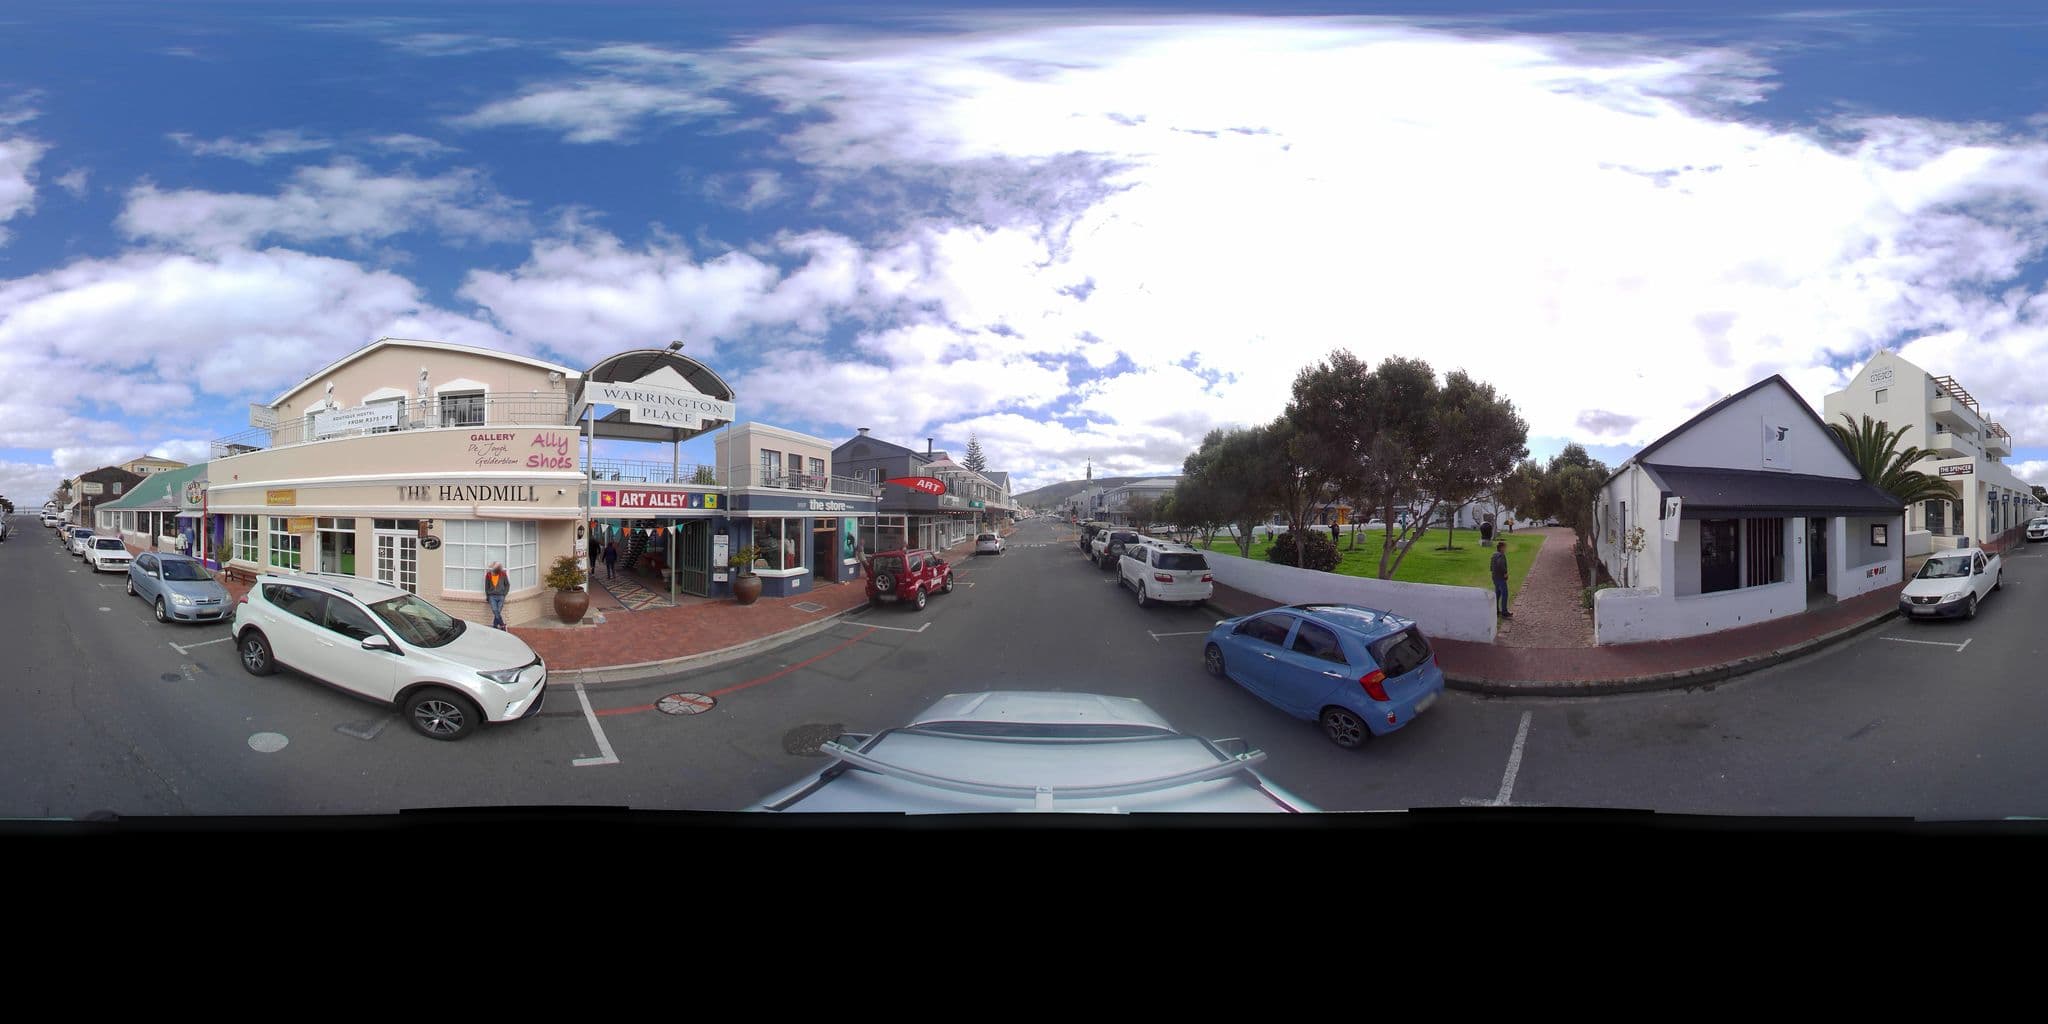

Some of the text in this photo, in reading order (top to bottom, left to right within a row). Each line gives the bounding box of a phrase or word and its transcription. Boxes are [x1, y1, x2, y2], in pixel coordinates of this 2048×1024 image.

[604, 389, 722, 413] WARRINGTON
[643, 408, 692, 422] PLACE
[470, 433, 515, 442] GALLERY
[531, 432, 568, 456] Ally
[526, 453, 572, 469] Shoes
[916, 479, 940, 492] ART
[397, 485, 539, 502] THE HANDMILL
[621, 493, 685, 507] ART ALLEY
[809, 499, 824, 511] the
[825, 500, 846, 511] store
